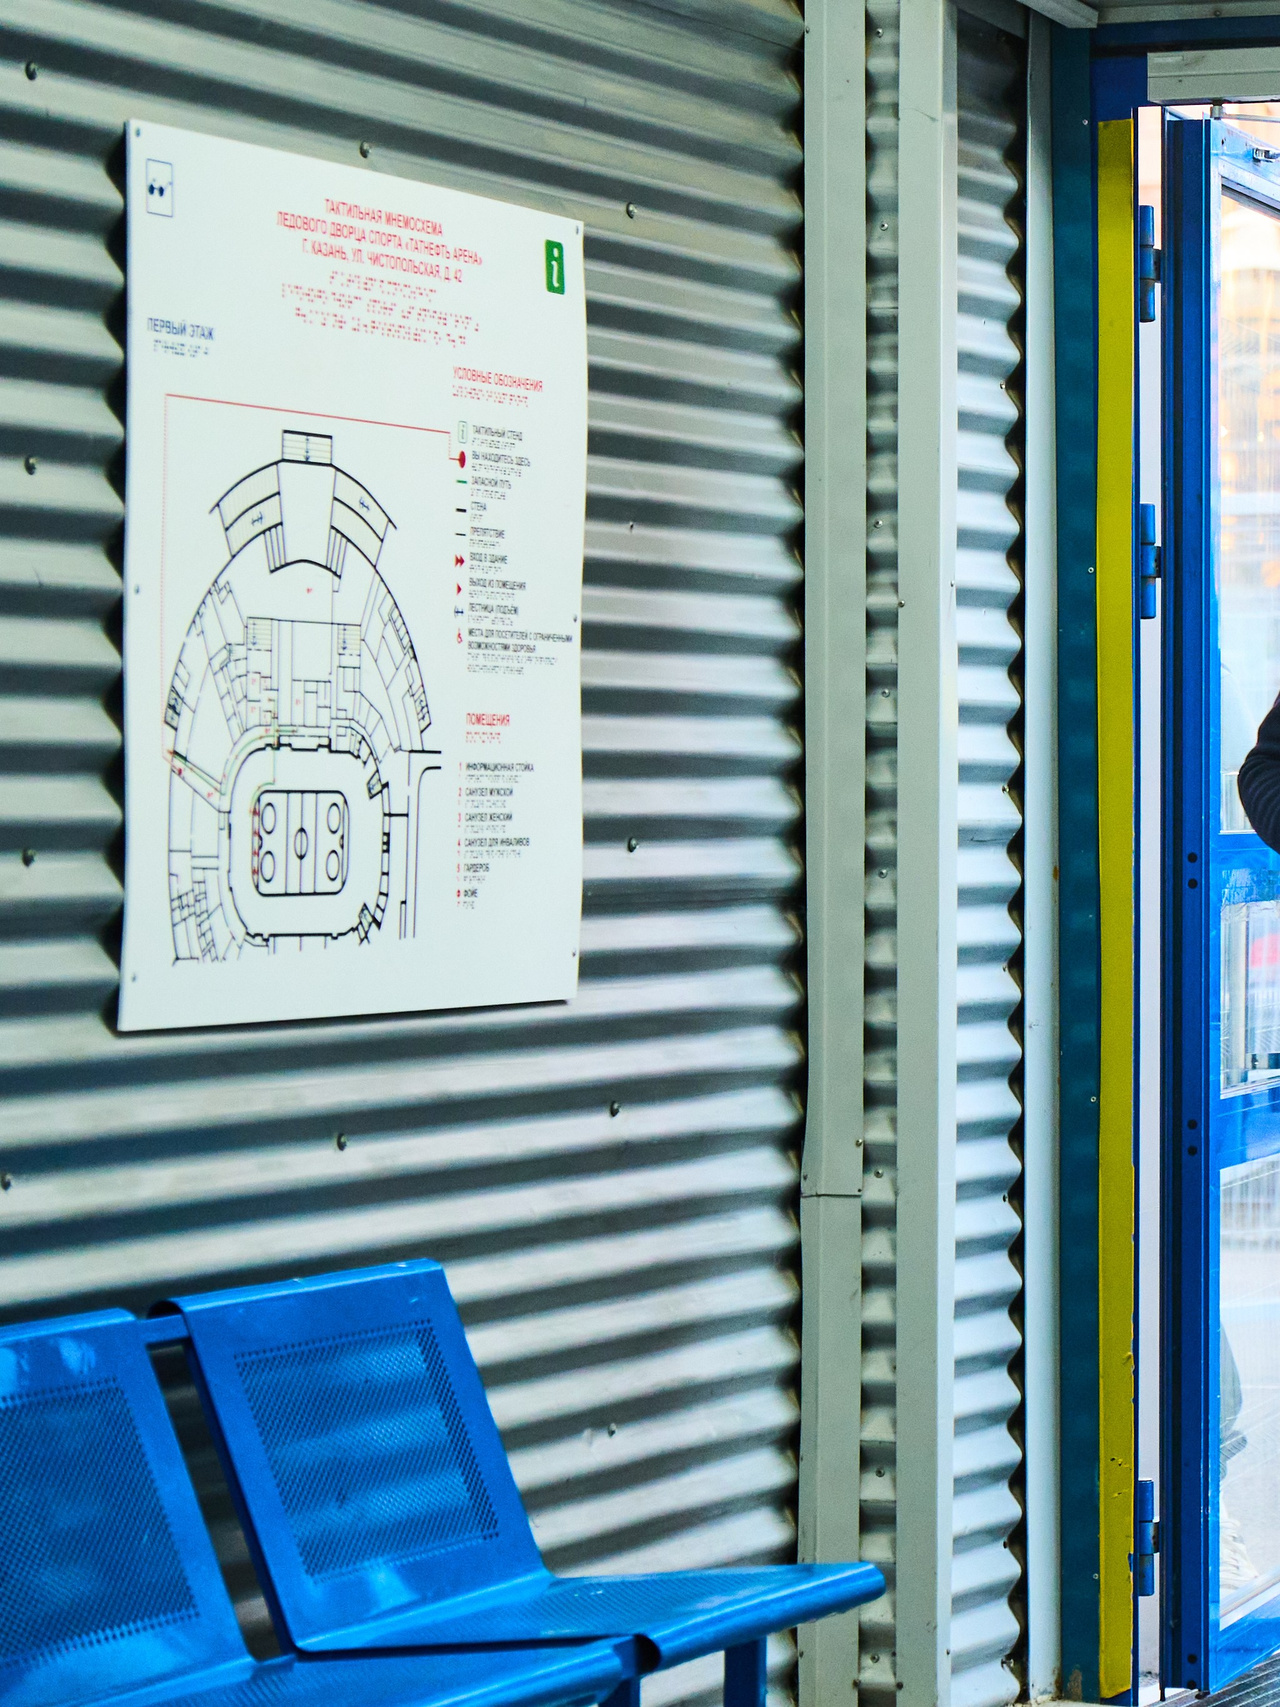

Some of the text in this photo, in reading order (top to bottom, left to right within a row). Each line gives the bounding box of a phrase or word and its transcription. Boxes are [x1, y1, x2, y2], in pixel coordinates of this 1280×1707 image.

[276, 211, 328, 235] ЛЕДОВОГО
[329, 222, 367, 243] ДВОРЦА
[369, 230, 402, 249] СПОРТА
[324, 198, 443, 237] ТАКТИЛЬНАЯ МНЕМОСХЕМА
[302, 238, 309, 253] Г.
[311, 240, 349, 263] КАЗАНЬ,
[351, 247, 365, 264] УЛ.
[367, 251, 442, 280] ЧИСТОПОЛЬСКАЯ,
[453, 268, 463, 283] 42
[147, 317, 214, 341] ПЕРВЫЙ ЭТАЖ
[453, 366, 543, 393] УСЛОВНЫЕ ОБОЗНАЧЕНИЯ
[466, 712, 510, 727] ПОМЕЩЕНИЯ
